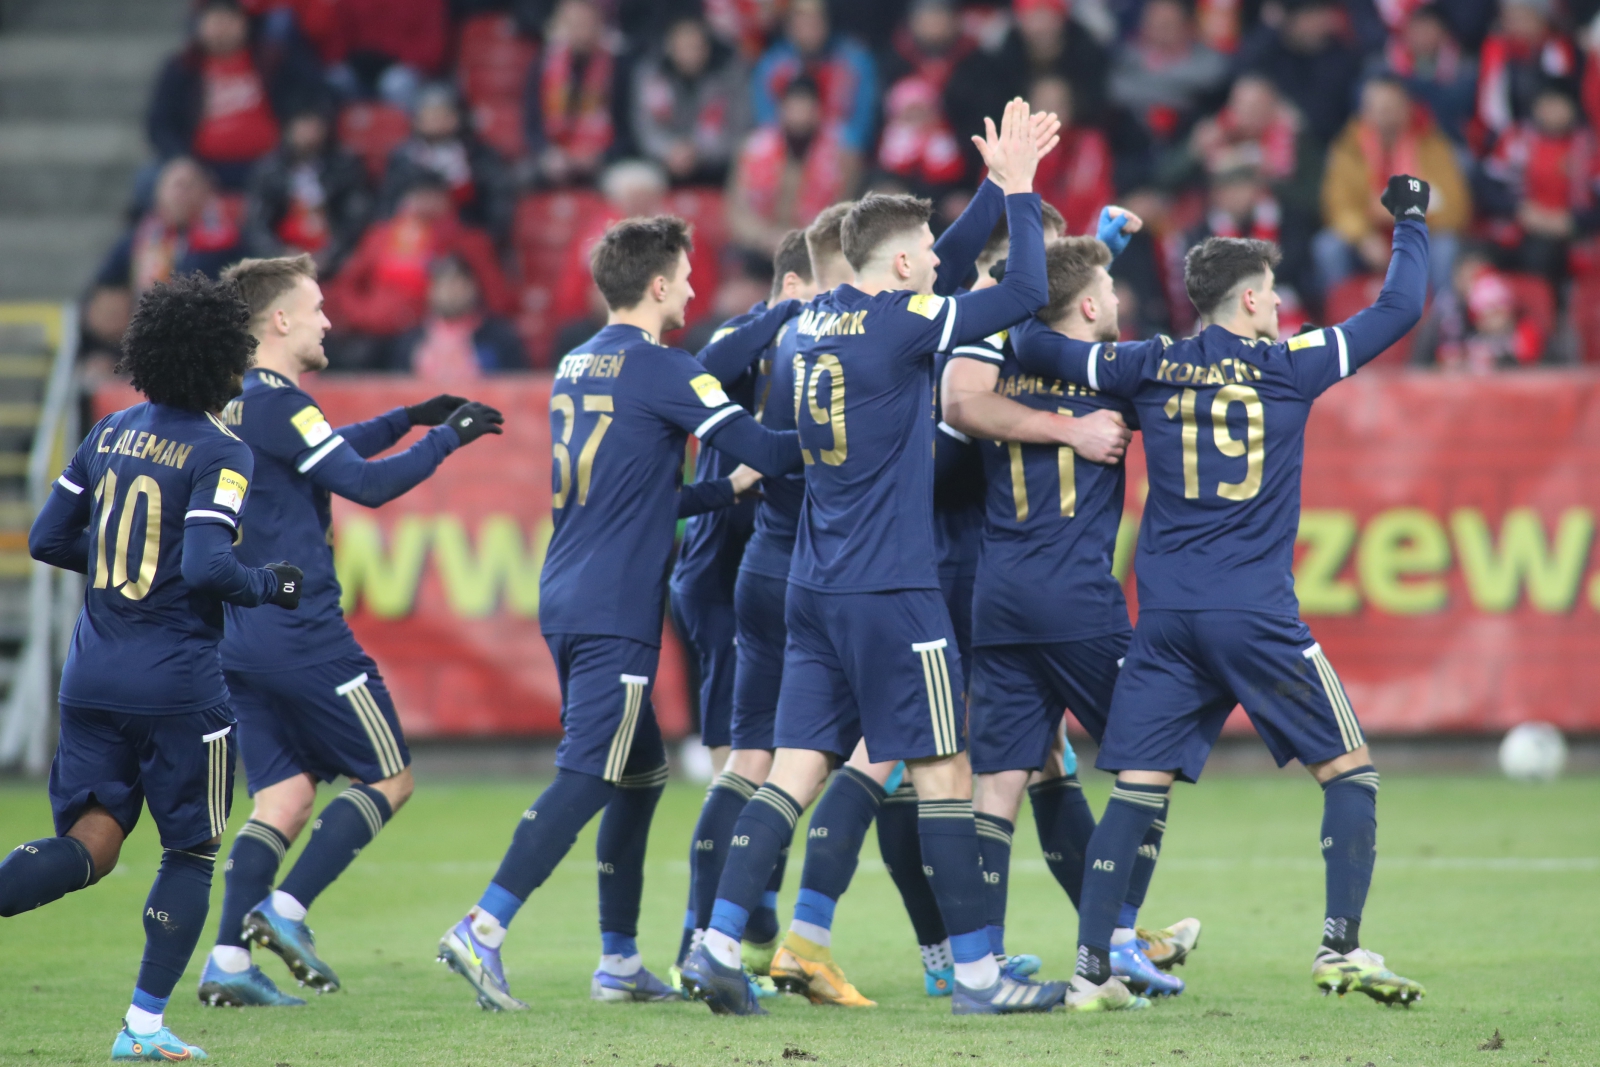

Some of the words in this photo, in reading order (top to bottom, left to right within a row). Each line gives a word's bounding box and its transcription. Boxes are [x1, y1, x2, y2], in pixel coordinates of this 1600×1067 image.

[1408, 179, 1421, 192] 19
[556, 349, 626, 385] STĘPIEŃ
[461, 416, 473, 427] 6
[1163, 384, 1265, 500] 19
[112, 428, 194, 470] ALEMAN
[551, 393, 615, 509] 37
[221, 476, 245, 493] FORTUNA
[93, 467, 162, 600] 10
[283, 581, 295, 594] 10
[809, 827, 828, 838] AG
[696, 840, 714, 851] AG
[731, 835, 750, 847] AG
[14, 845, 39, 857] AG
[598, 861, 615, 874] AG
[1092, 858, 1115, 872] AG
[982, 871, 1000, 884] AG
[146, 907, 171, 922] AG
